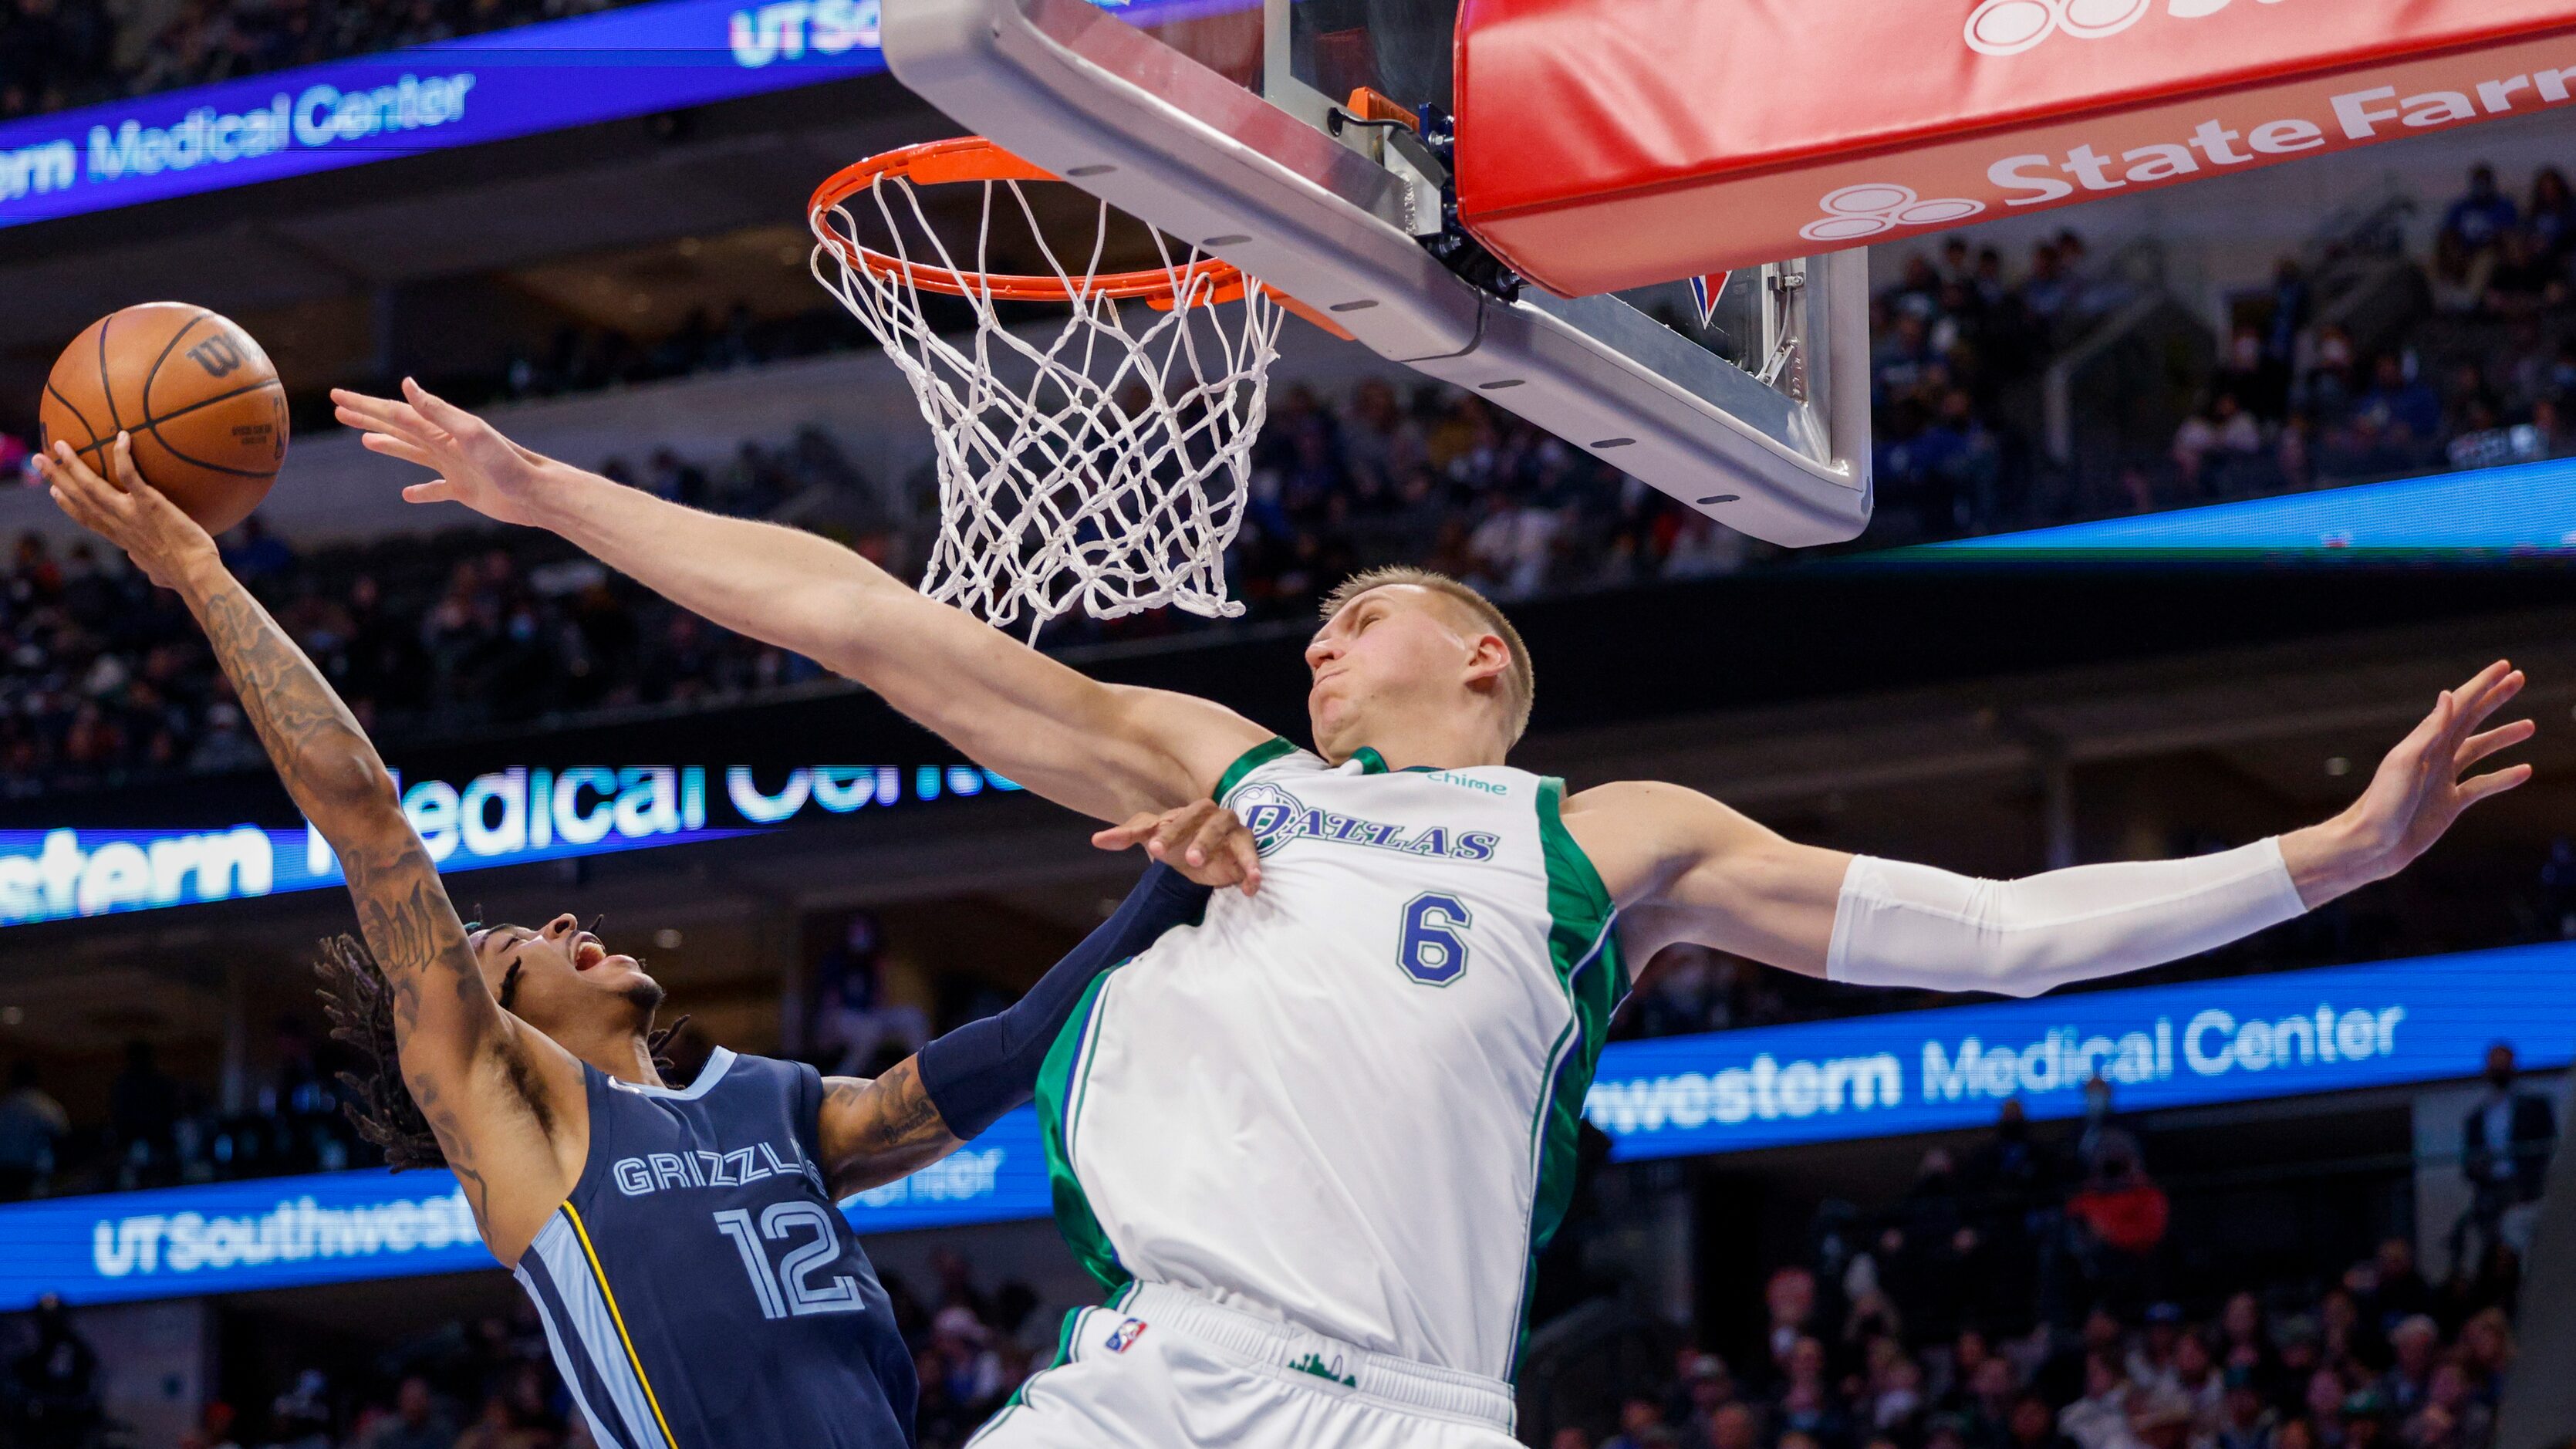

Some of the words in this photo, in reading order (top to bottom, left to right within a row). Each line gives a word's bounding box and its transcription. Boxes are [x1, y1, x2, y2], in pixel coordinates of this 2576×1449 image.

[86, 91, 291, 183] Medical
[292, 71, 476, 147] Center
[1987, 119, 2325, 206] State
[1427, 770, 1508, 796] chime
[1243, 803, 1501, 863] DALLAS
[1396, 890, 1473, 988] 6
[1921, 1015, 2174, 1105] Medical
[2183, 1000, 2408, 1077] Center
[712, 1200, 866, 1319] 12
